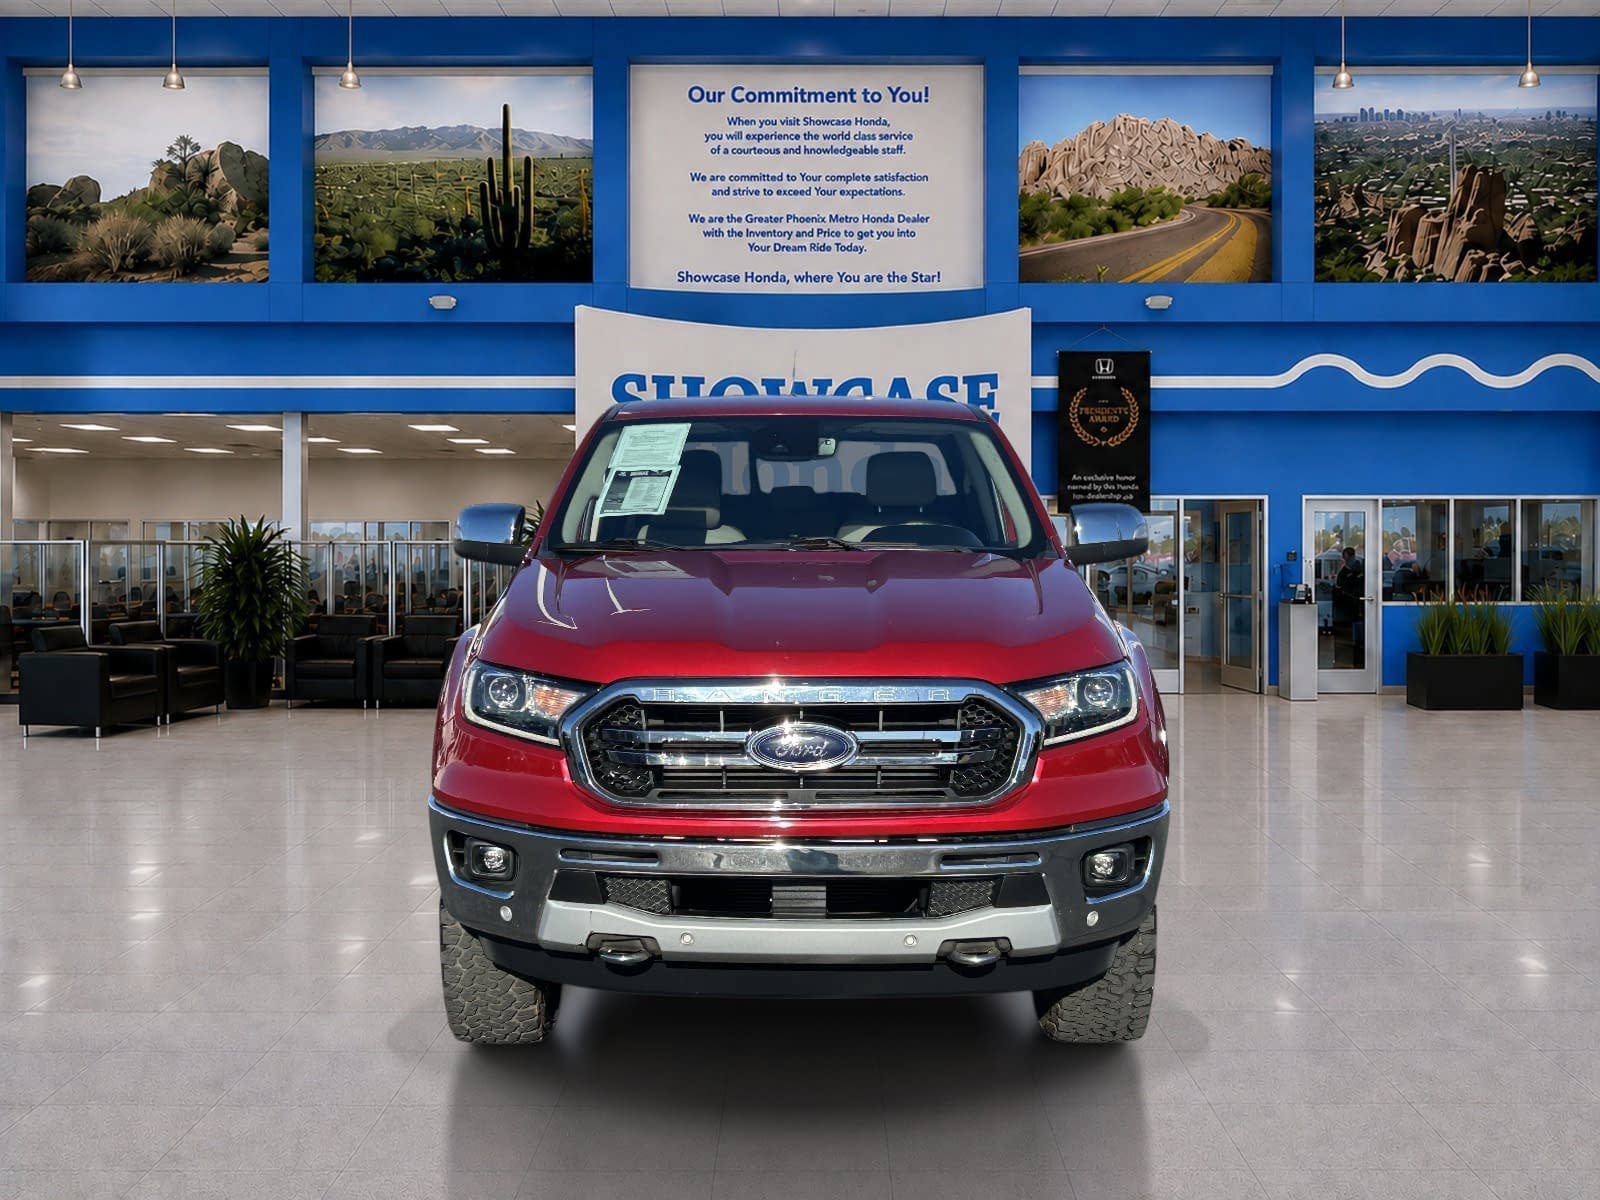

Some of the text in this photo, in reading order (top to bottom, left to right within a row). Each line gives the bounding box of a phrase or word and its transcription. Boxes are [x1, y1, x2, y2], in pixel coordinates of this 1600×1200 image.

[687, 86, 929, 103] Our Commitment to You!
[727, 117, 890, 128] When you visit Showcase Honda,
[705, 131, 913, 143] you will experience the world class service
[711, 146, 721, 155] of
[731, 146, 781, 155] courteous
[783, 146, 801, 155] and
[881, 146, 906, 155] staff.
[690, 172, 707, 182] We
[729, 172, 783, 182] committed
[786, 172, 797, 182] to
[800, 172, 822, 182] Your
[825, 172, 871, 184] complete
[874, 172, 928, 182] satisfaction
[712, 187, 905, 199] and strive to exceed Your expectations.
[689, 214, 706, 223] We
[726, 214, 743, 223] the
[745, 214, 784, 223] Greater
[786, 214, 827, 223] Phoenix
[829, 214, 859, 223] Metro
[862, 214, 895, 223] Honda
[897, 214, 930, 223] Dealer
[702, 228, 916, 240] with the Inventory and Price to get you into
[748, 242, 867, 254] Your Dream Ride Today.
[676, 270, 941, 286] Showcase Honda, where You are the Star!
[653, 688, 950, 702] RANGER
[775, 736, 829, 757] Ford
